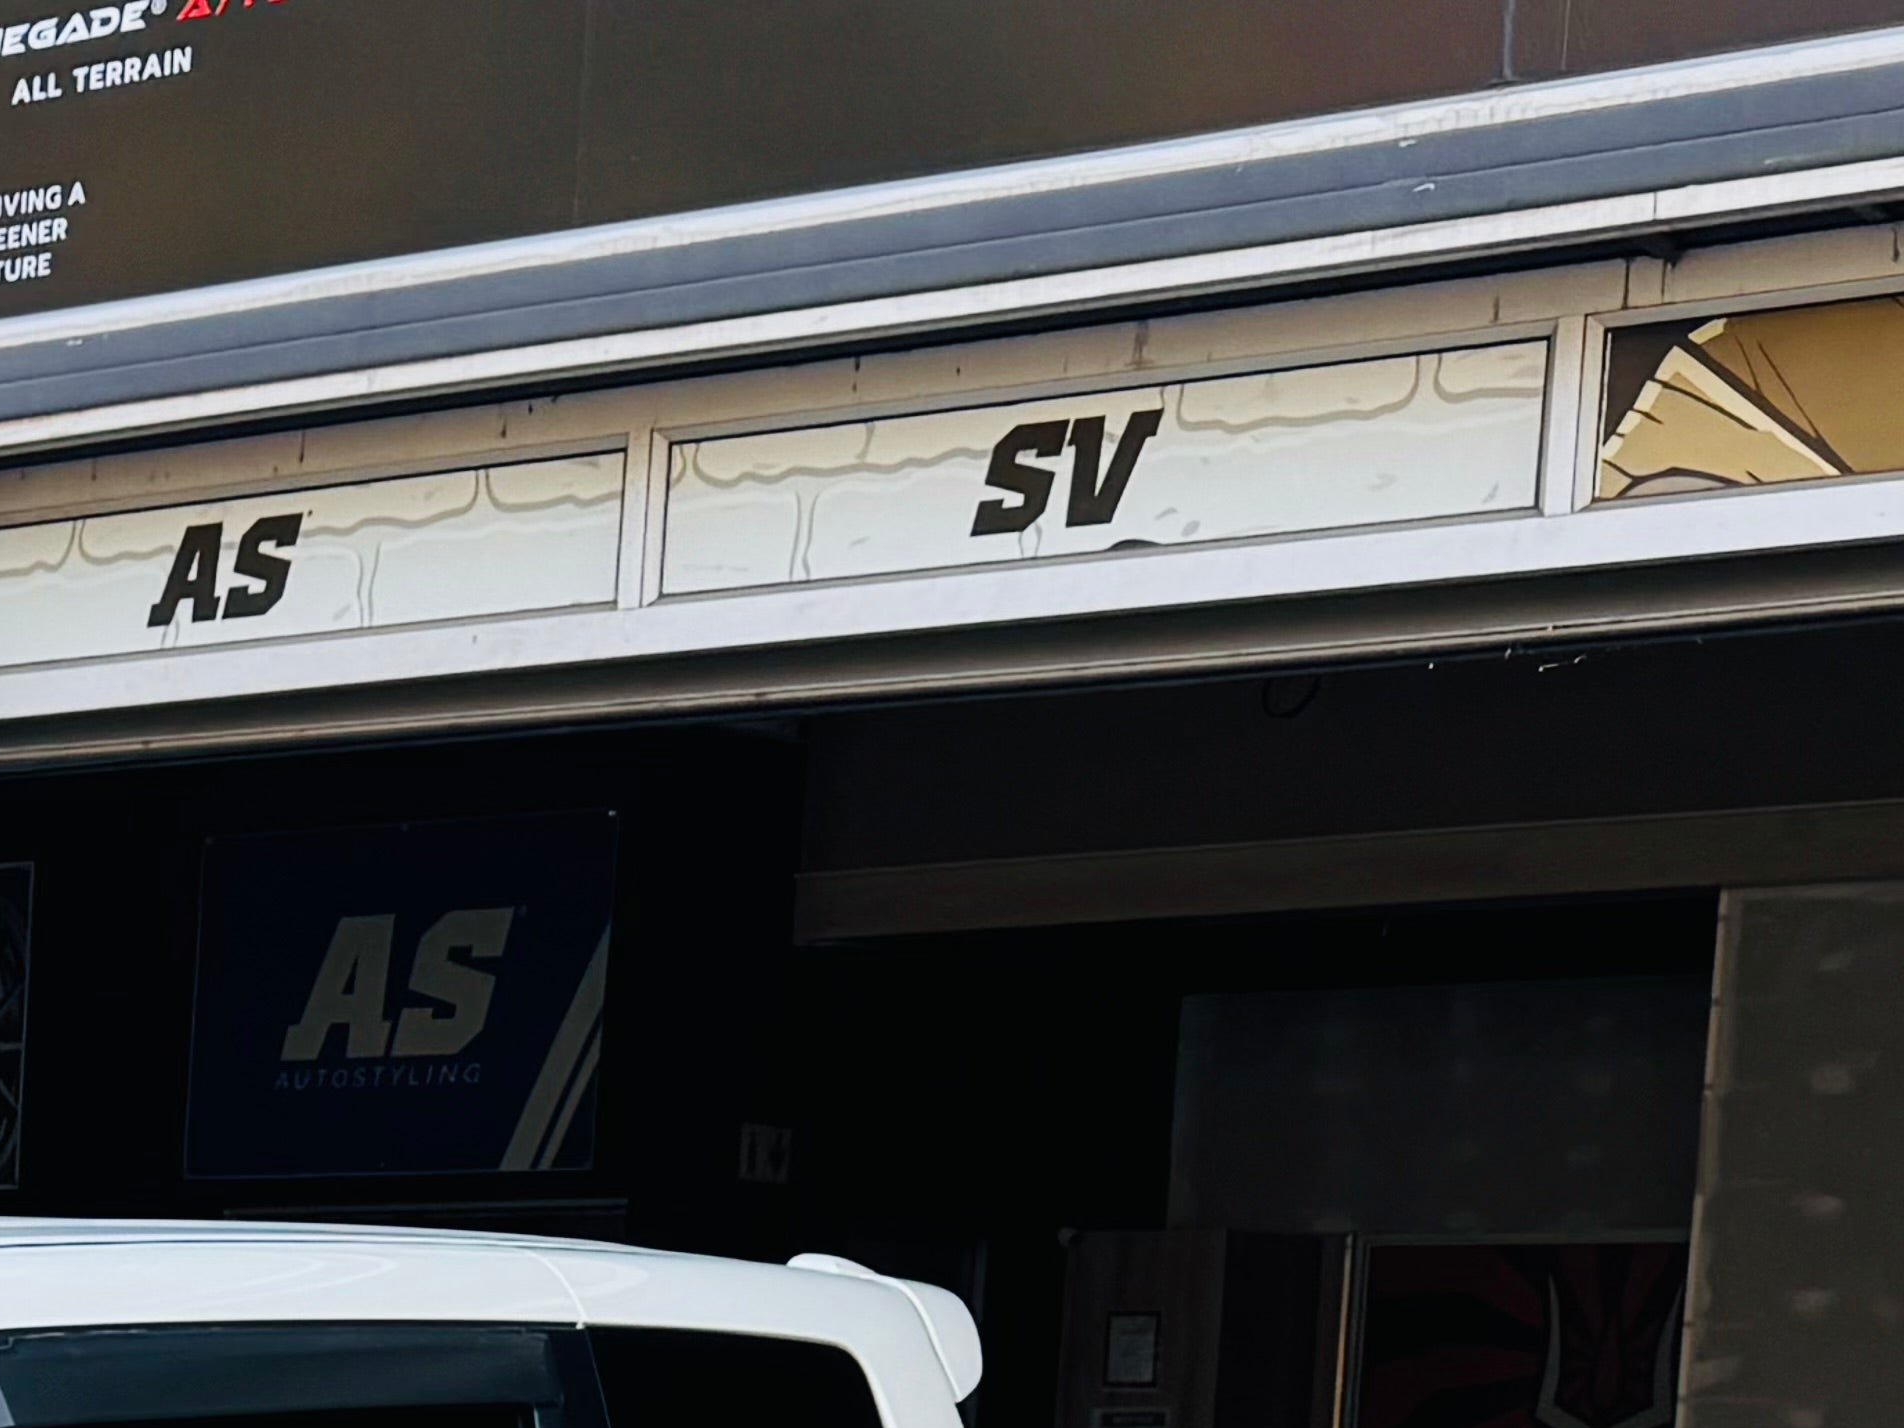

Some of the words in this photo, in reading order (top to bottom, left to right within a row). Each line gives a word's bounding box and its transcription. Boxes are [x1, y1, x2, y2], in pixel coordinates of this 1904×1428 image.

[10, 72, 63, 106] ALL
[73, 46, 192, 94] TERRAIN
[67, 181, 86, 206] A
[969, 409, 1163, 538] SV
[147, 512, 305, 628] AS
[279, 906, 516, 1062] AS
[273, 1060, 482, 1091] AUTOSTYLING
